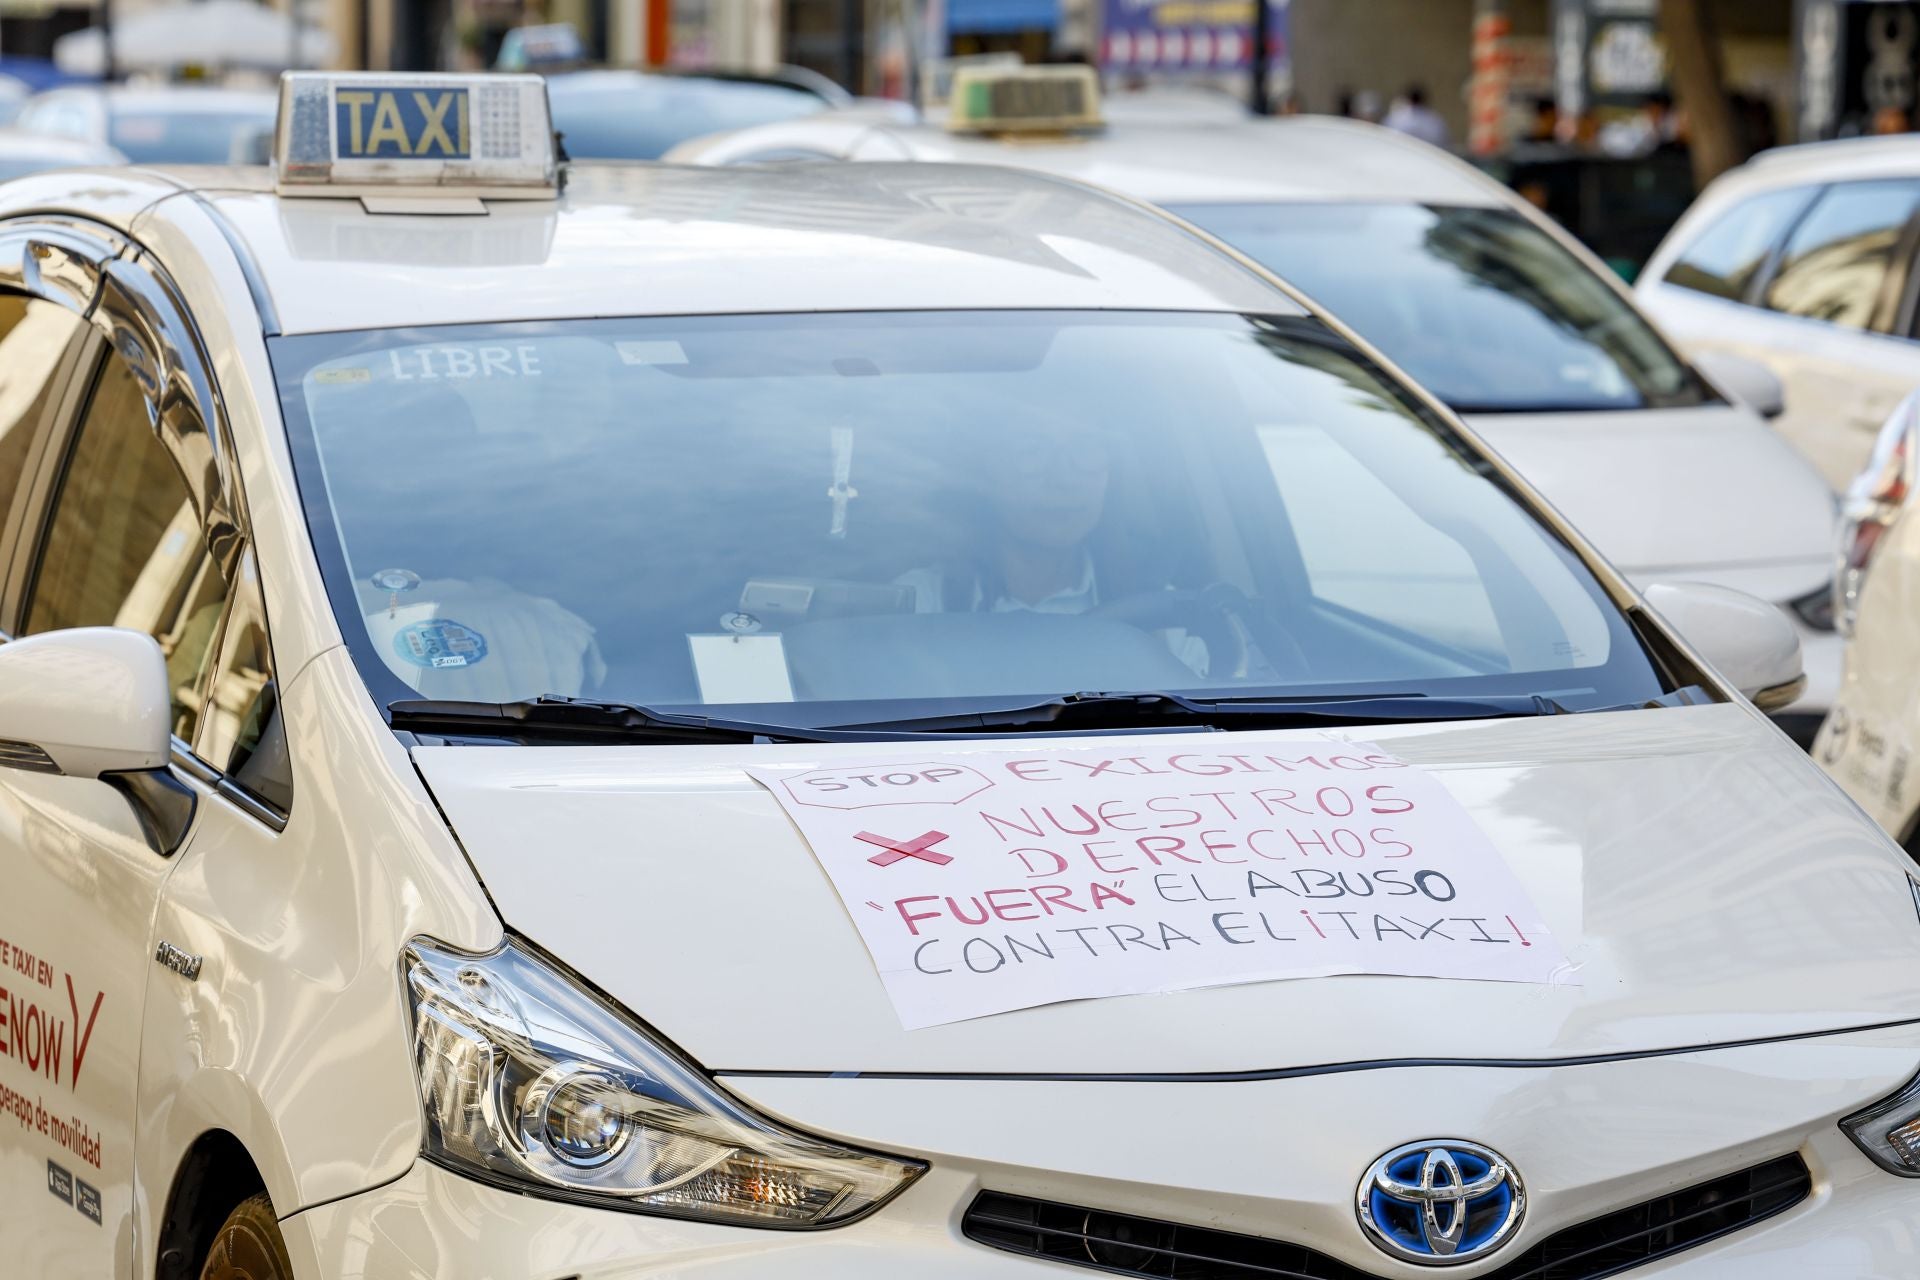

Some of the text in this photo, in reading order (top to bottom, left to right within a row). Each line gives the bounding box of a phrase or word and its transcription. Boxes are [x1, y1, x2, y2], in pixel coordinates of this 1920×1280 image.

[336, 92, 470, 154] TAXI
[389, 346, 543, 380] LIBRE
[804, 767, 963, 792] STOP
[1005, 753, 1409, 781] EXIGIMOS
[979, 785, 1415, 842] NUESTROS
[1008, 827, 1414, 878] DERECHOS
[1153, 873, 1237, 902] EL
[1247, 869, 1457, 902] ABUSO
[12, 946, 35, 980] TAXI
[38, 960, 53, 989] EN
[914, 922, 1201, 974] CONTRA
[35, 1096, 49, 1136] de
[51, 1113, 101, 1170] movilidad
